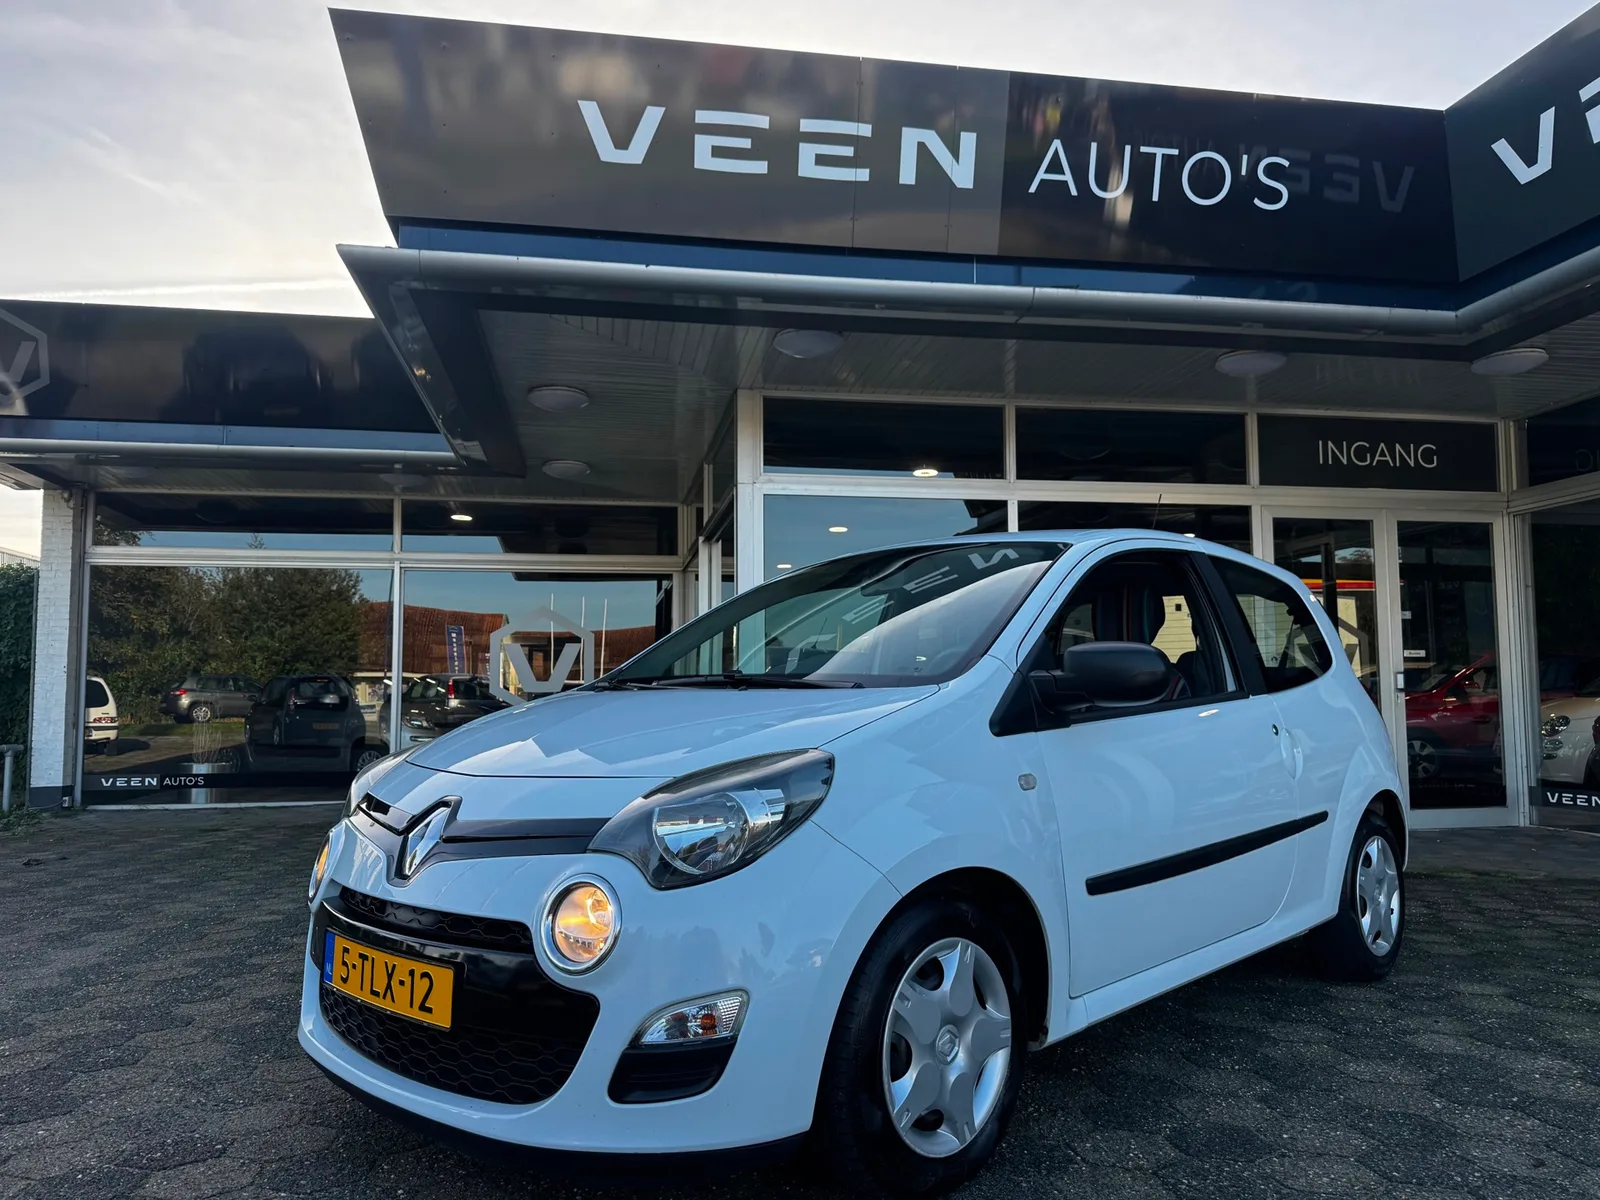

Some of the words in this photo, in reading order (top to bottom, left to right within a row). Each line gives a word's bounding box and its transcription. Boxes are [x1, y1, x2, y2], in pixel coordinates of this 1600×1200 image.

[576, 99, 978, 190] VEEN
[1027, 138, 1291, 211] AUTO'S
[1317, 439, 1438, 469] INGANG
[100, 776, 158, 787] VEEN
[162, 776, 205, 786] AUTO'S
[1546, 791, 1600, 807] VEEN
[339, 944, 435, 1015] 5-TLX-12
